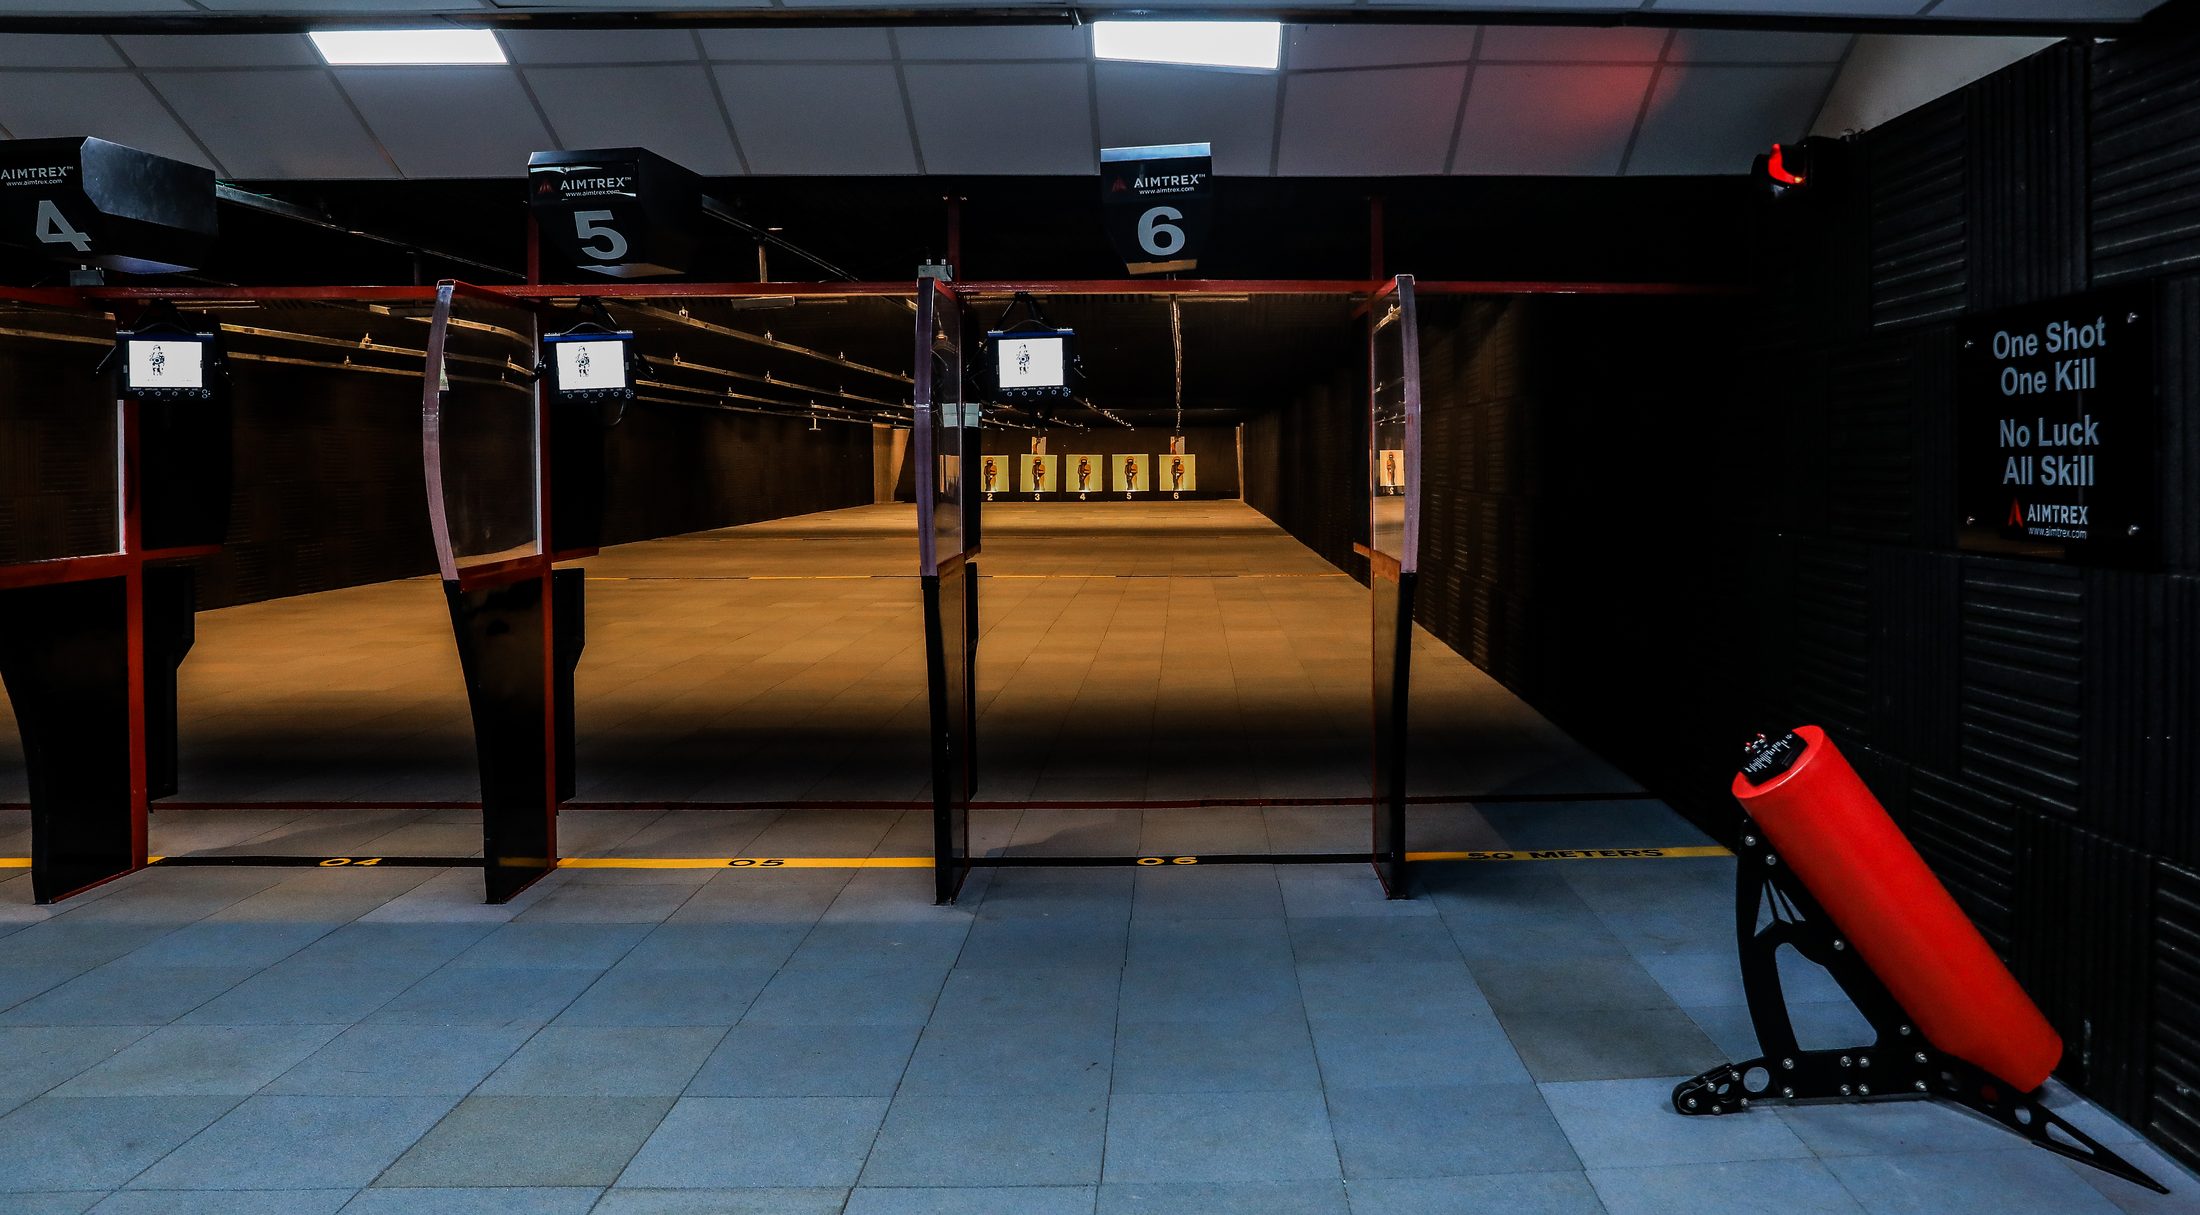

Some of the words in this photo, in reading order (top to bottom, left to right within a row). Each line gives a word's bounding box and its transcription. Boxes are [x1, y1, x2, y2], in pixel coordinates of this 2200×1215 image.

[6, 178, 63, 186] www.aimtrex.com
[1139, 186, 1194, 195] www.aimtrex.com
[36, 200, 92, 251] 4
[1137, 206, 1185, 256] 6
[574, 209, 628, 260] 5
[1993, 330, 2038, 360] One
[2045, 315, 2107, 353] Shot
[2000, 366, 2047, 396] One
[2055, 357, 2096, 392] Kill
[2000, 418, 2030, 448] No
[2038, 414, 2099, 447] Luck
[2002, 456, 2033, 485] All
[2040, 455, 2094, 486] Skill
[987, 493, 993, 501] 2
[1034, 493, 1040, 501] 3
[1079, 493, 1086, 501] 4
[1173, 492, 1180, 500] 6
[2027, 504, 2088, 525] AIMTREX
[2028, 526, 2087, 539] www.aimtrex.com
[1467, 852, 1514, 860] 50
[1529, 850, 1664, 858] METERS
[319, 858, 382, 867] 04
[1136, 857, 1198, 866] 06
